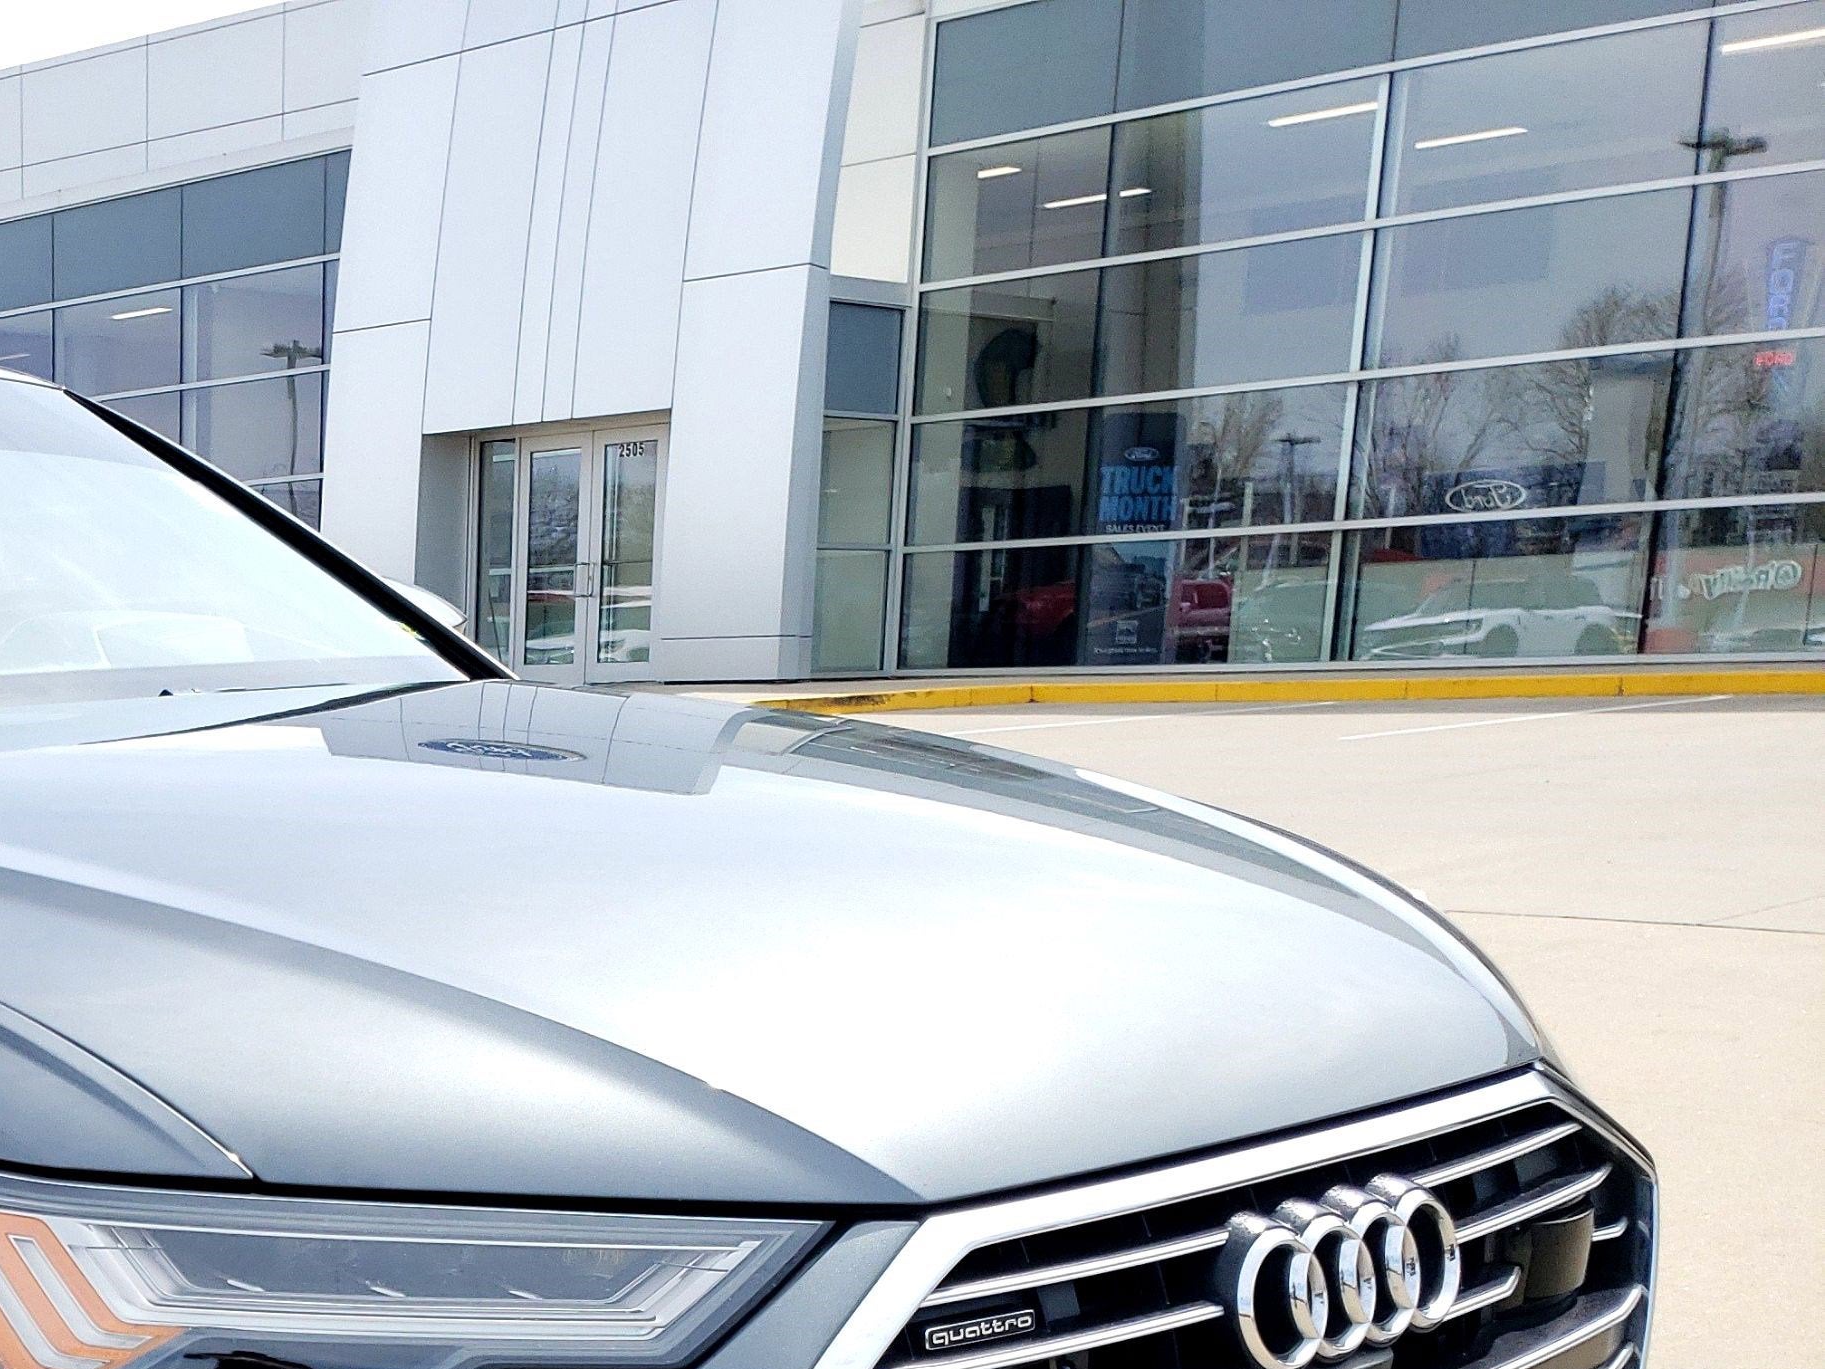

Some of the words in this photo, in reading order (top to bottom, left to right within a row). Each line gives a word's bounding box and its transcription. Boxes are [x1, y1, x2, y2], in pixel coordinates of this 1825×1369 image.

[618, 442, 645, 458] 2505
[1099, 466, 1178, 495] TRUCK
[1098, 495, 1177, 522] MONTH
[932, 1315, 1032, 1345] quattro
